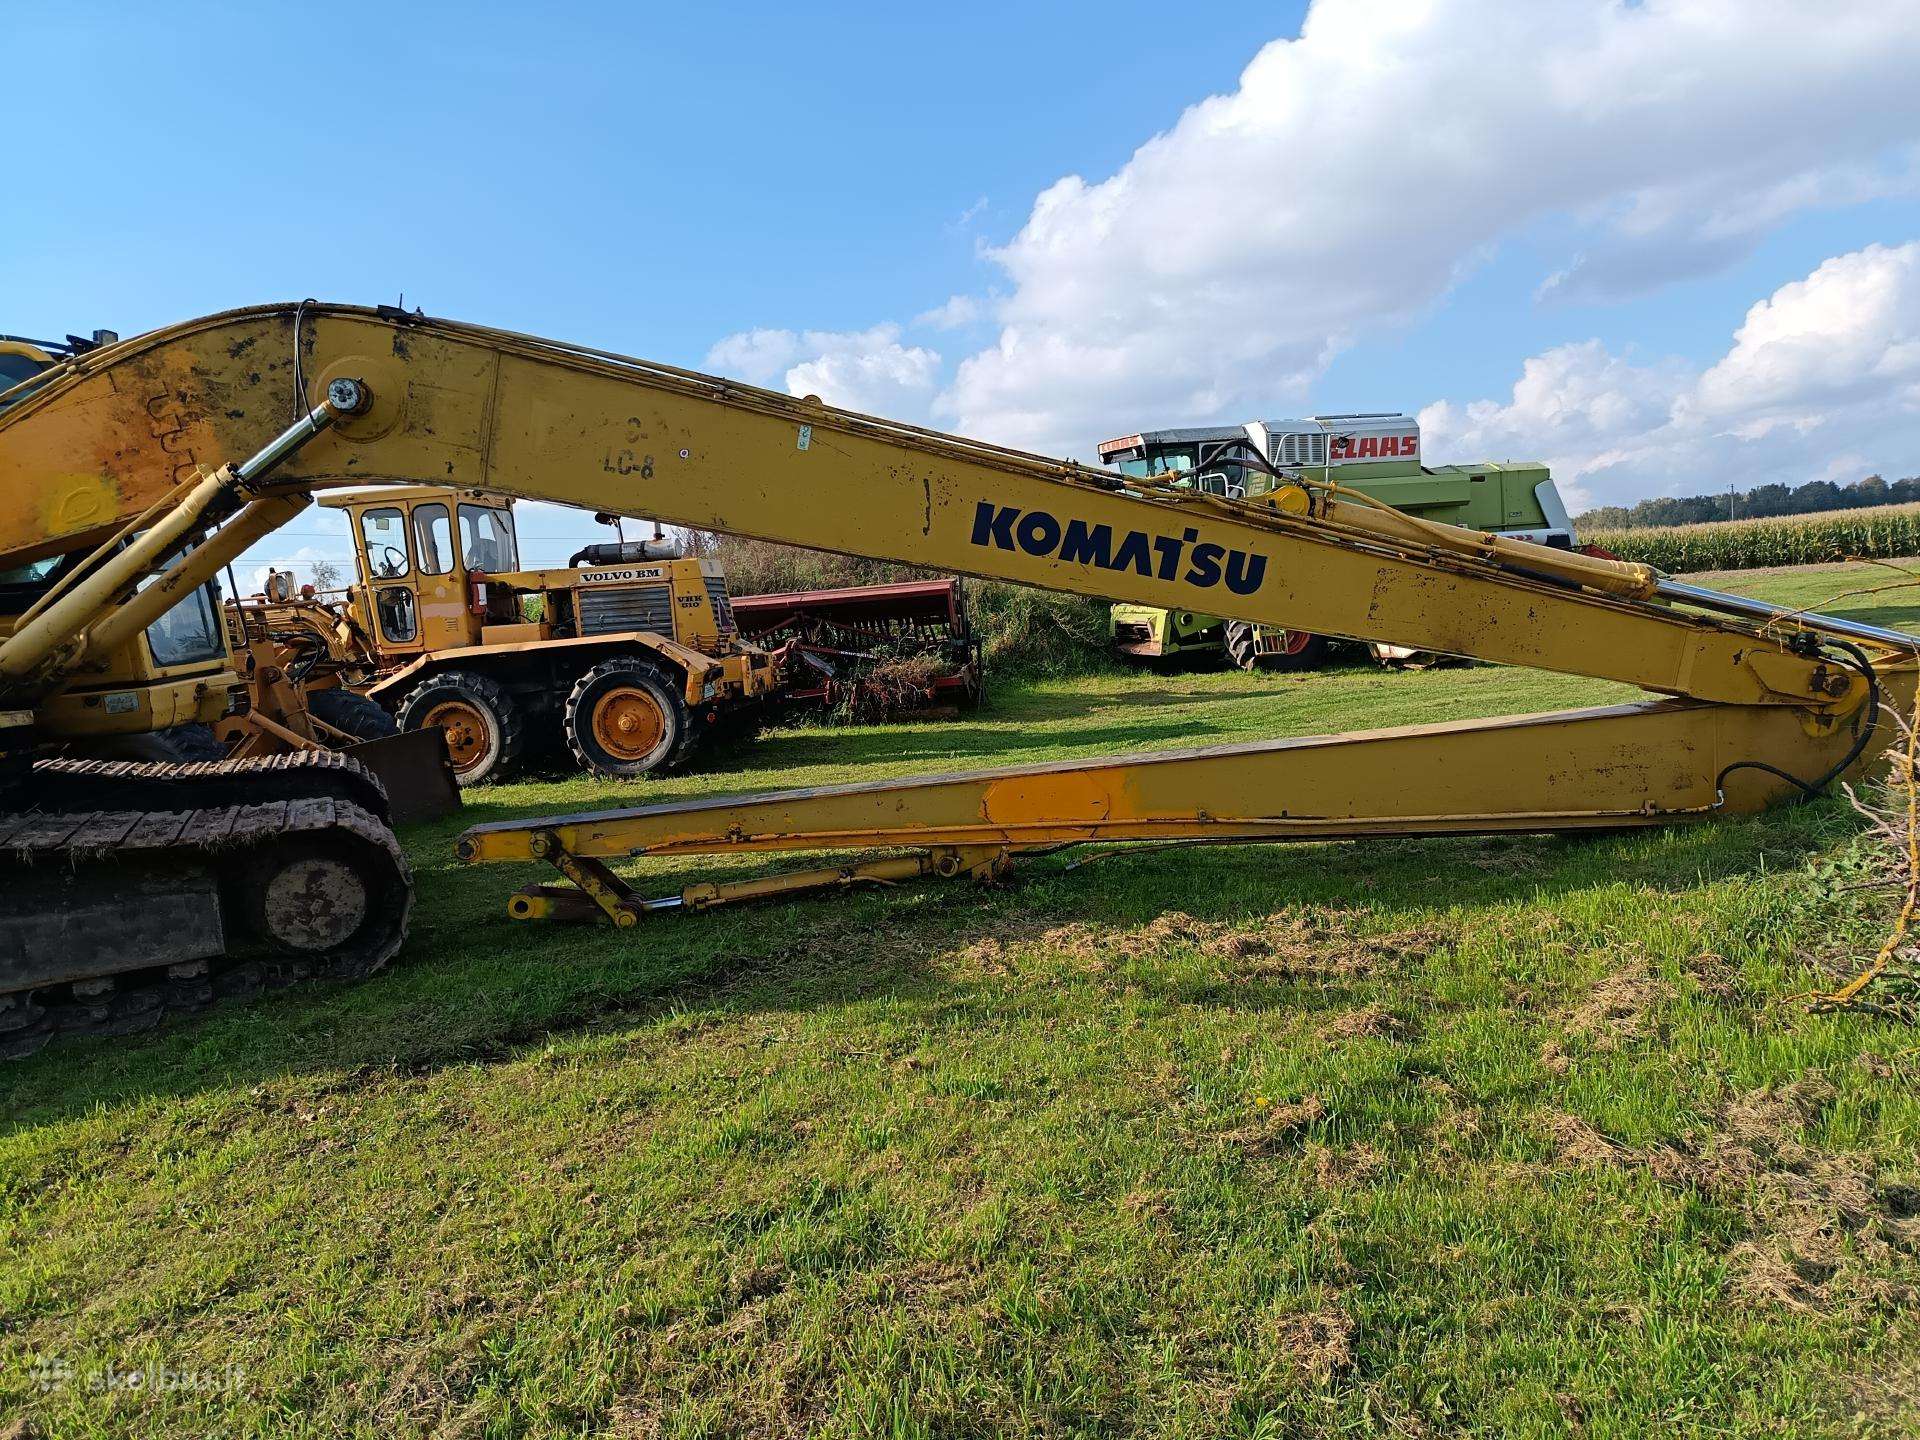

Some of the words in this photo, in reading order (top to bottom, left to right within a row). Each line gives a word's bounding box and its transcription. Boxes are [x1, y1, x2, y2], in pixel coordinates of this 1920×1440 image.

[1330, 436, 1417, 459] CLAAS
[970, 501, 1268, 595] KOMATSU
[581, 571, 632, 582] VOLVO
[635, 568, 660, 578] BM
